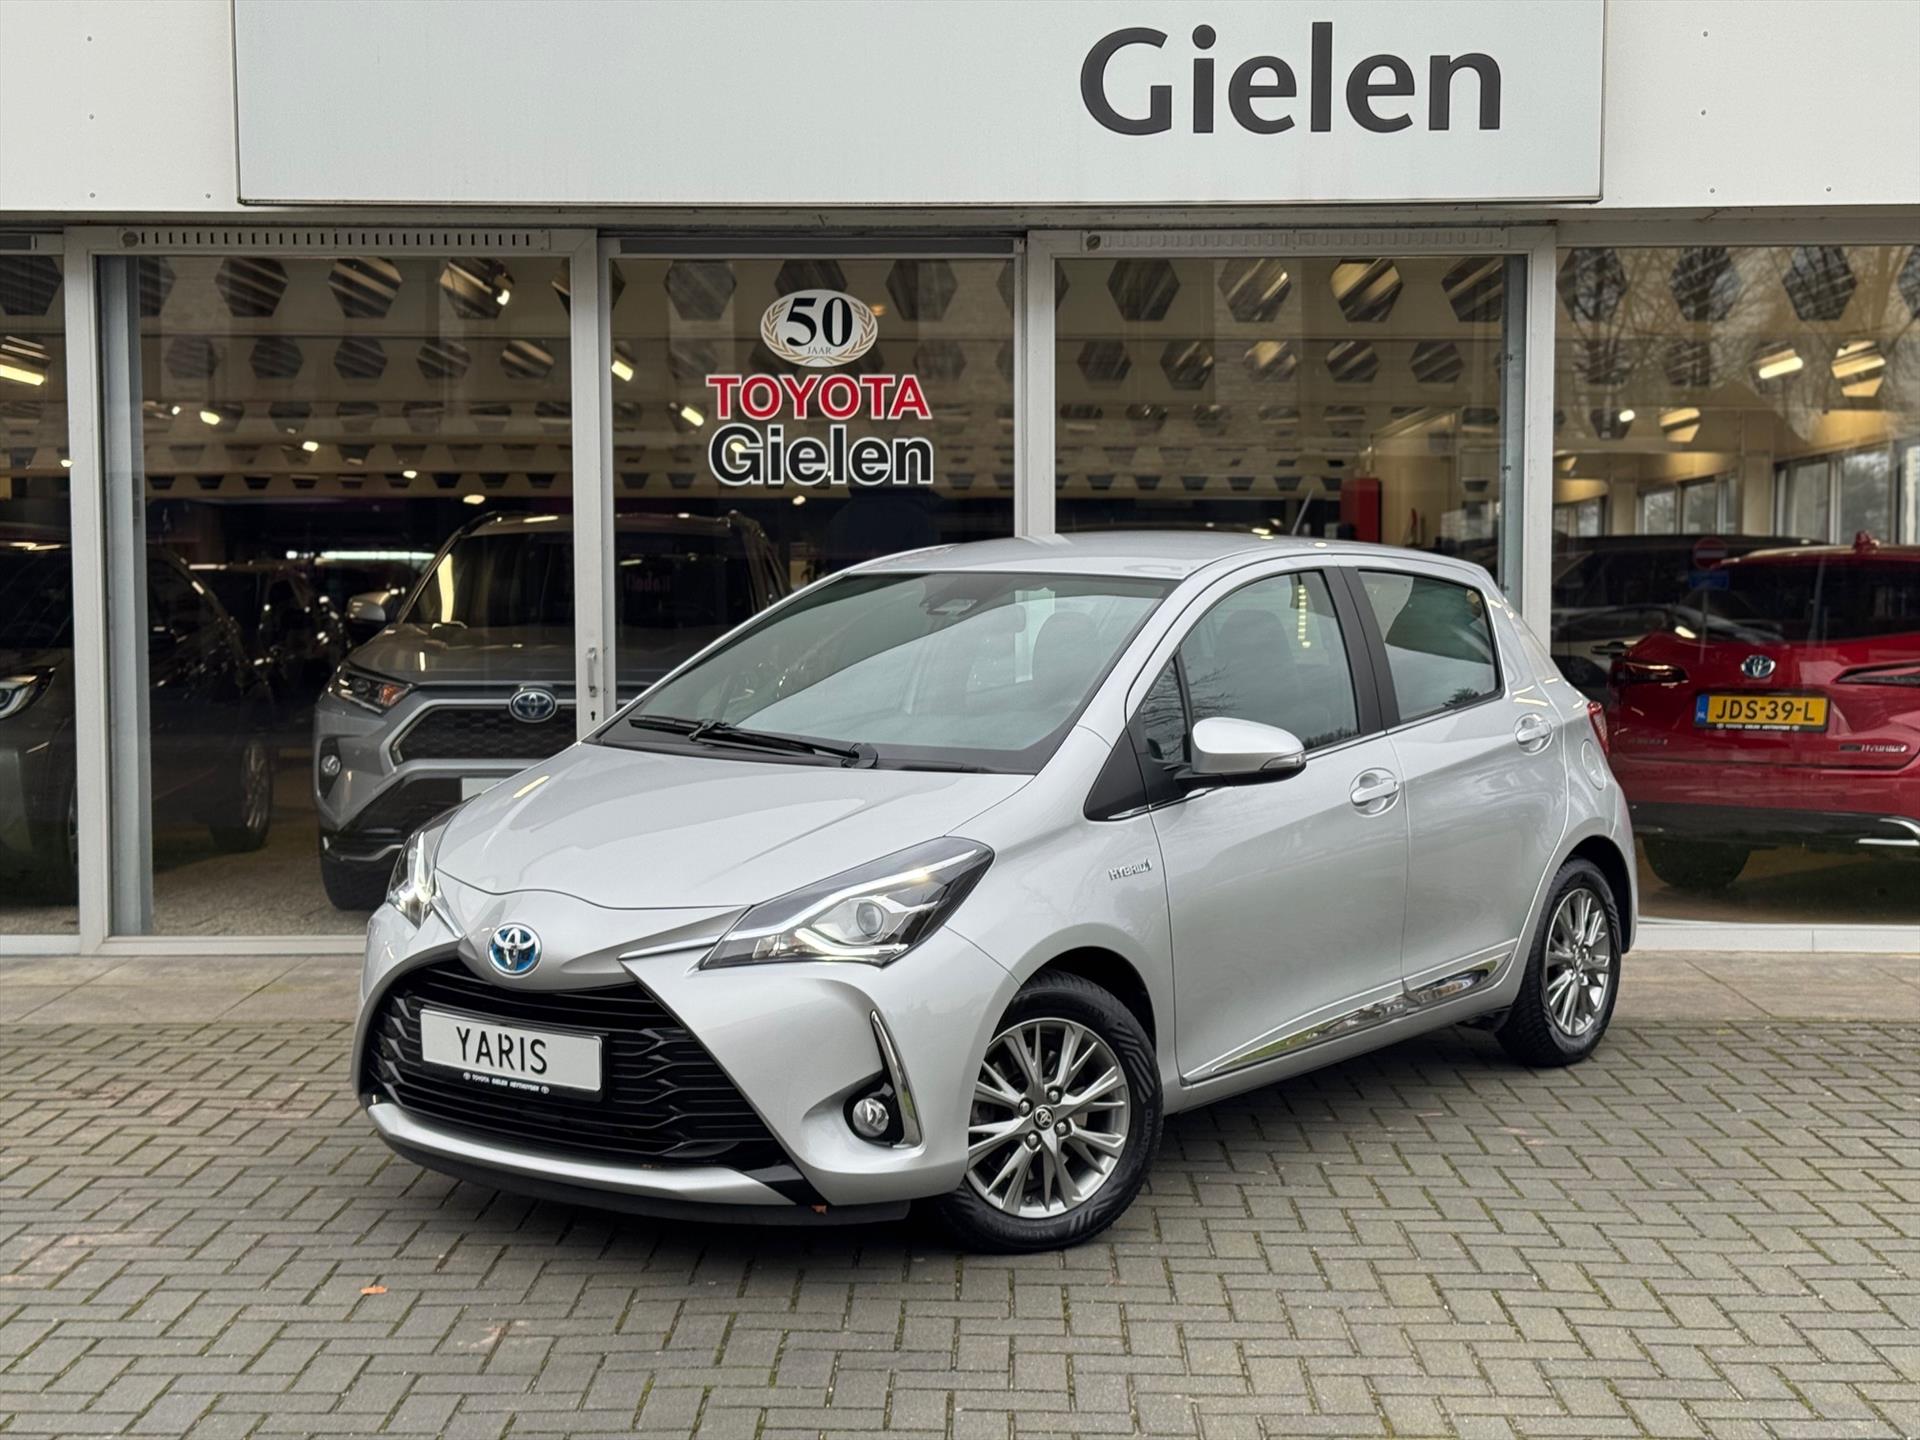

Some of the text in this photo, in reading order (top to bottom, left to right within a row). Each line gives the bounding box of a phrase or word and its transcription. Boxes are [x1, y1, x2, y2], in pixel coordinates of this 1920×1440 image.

[1080, 21, 1501, 136] Gielen
[786, 297, 853, 347] 50
[807, 347, 832, 355] JAAR
[705, 374, 933, 420] TOYOTA
[708, 422, 934, 486] Gielen
[1715, 699, 1815, 721] JDS-39-L
[1107, 862, 1147, 880] HYBRID
[456, 1026, 548, 1075] YARIS
